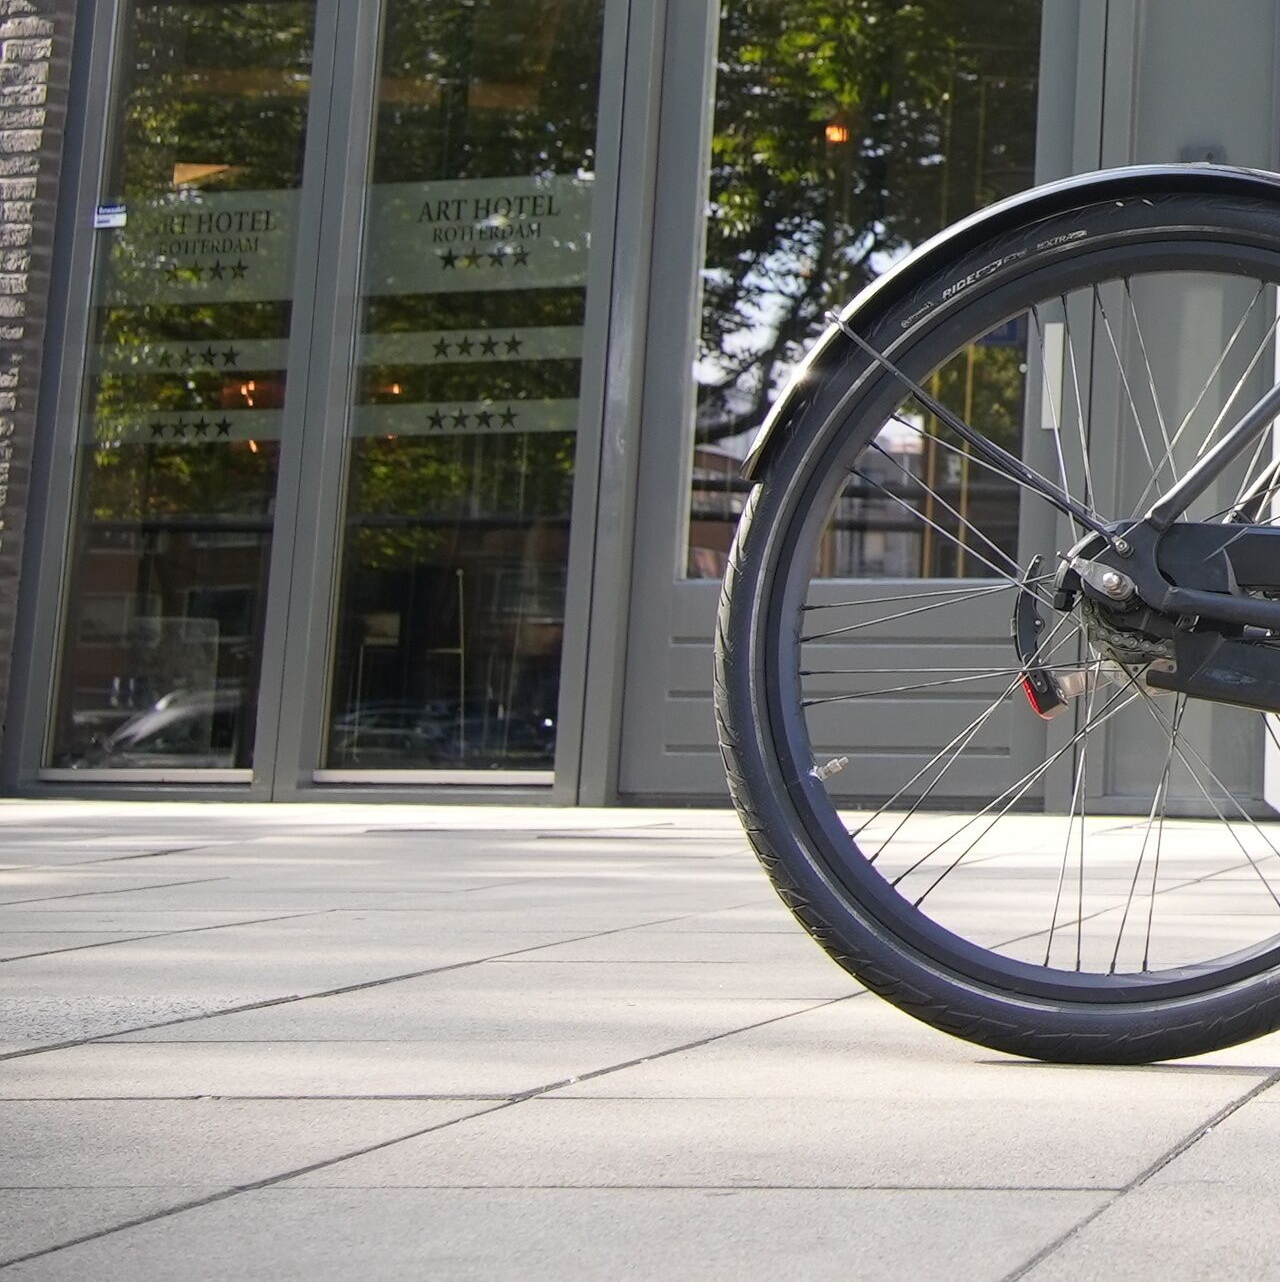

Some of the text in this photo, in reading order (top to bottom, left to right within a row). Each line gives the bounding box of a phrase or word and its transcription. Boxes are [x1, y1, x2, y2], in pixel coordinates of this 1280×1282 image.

[417, 195, 561, 222] ART HOTEL
[197, 210, 277, 233] HOTEL
[432, 222, 541, 243] ROTTERDAM
[943, 272, 976, 300] RIDE
